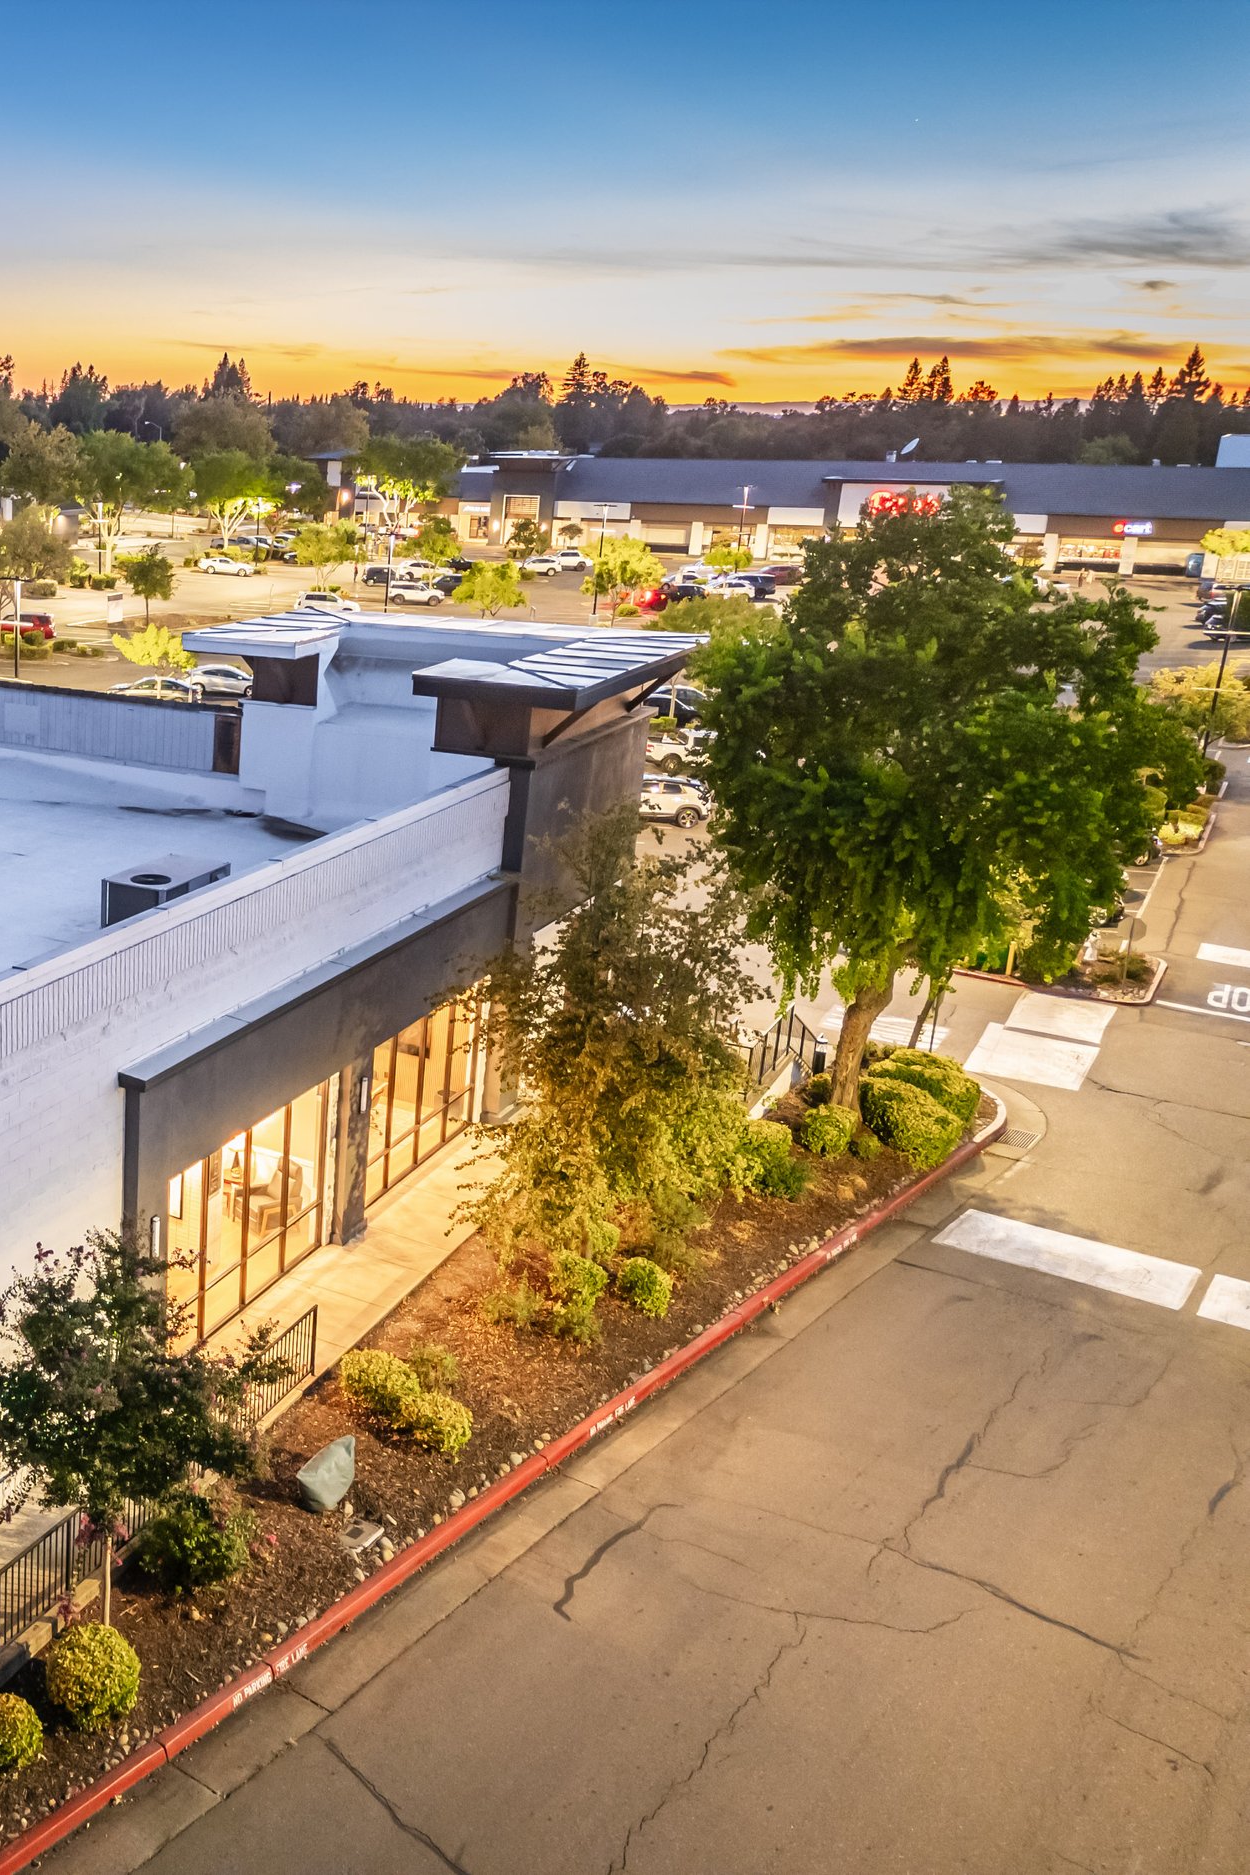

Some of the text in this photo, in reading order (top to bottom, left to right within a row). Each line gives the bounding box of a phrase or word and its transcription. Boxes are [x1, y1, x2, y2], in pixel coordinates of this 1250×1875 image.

[232, 1692, 243, 1708] NO
[244, 1671, 272, 1698] PARKING
[291, 1643, 309, 1664] LANE
